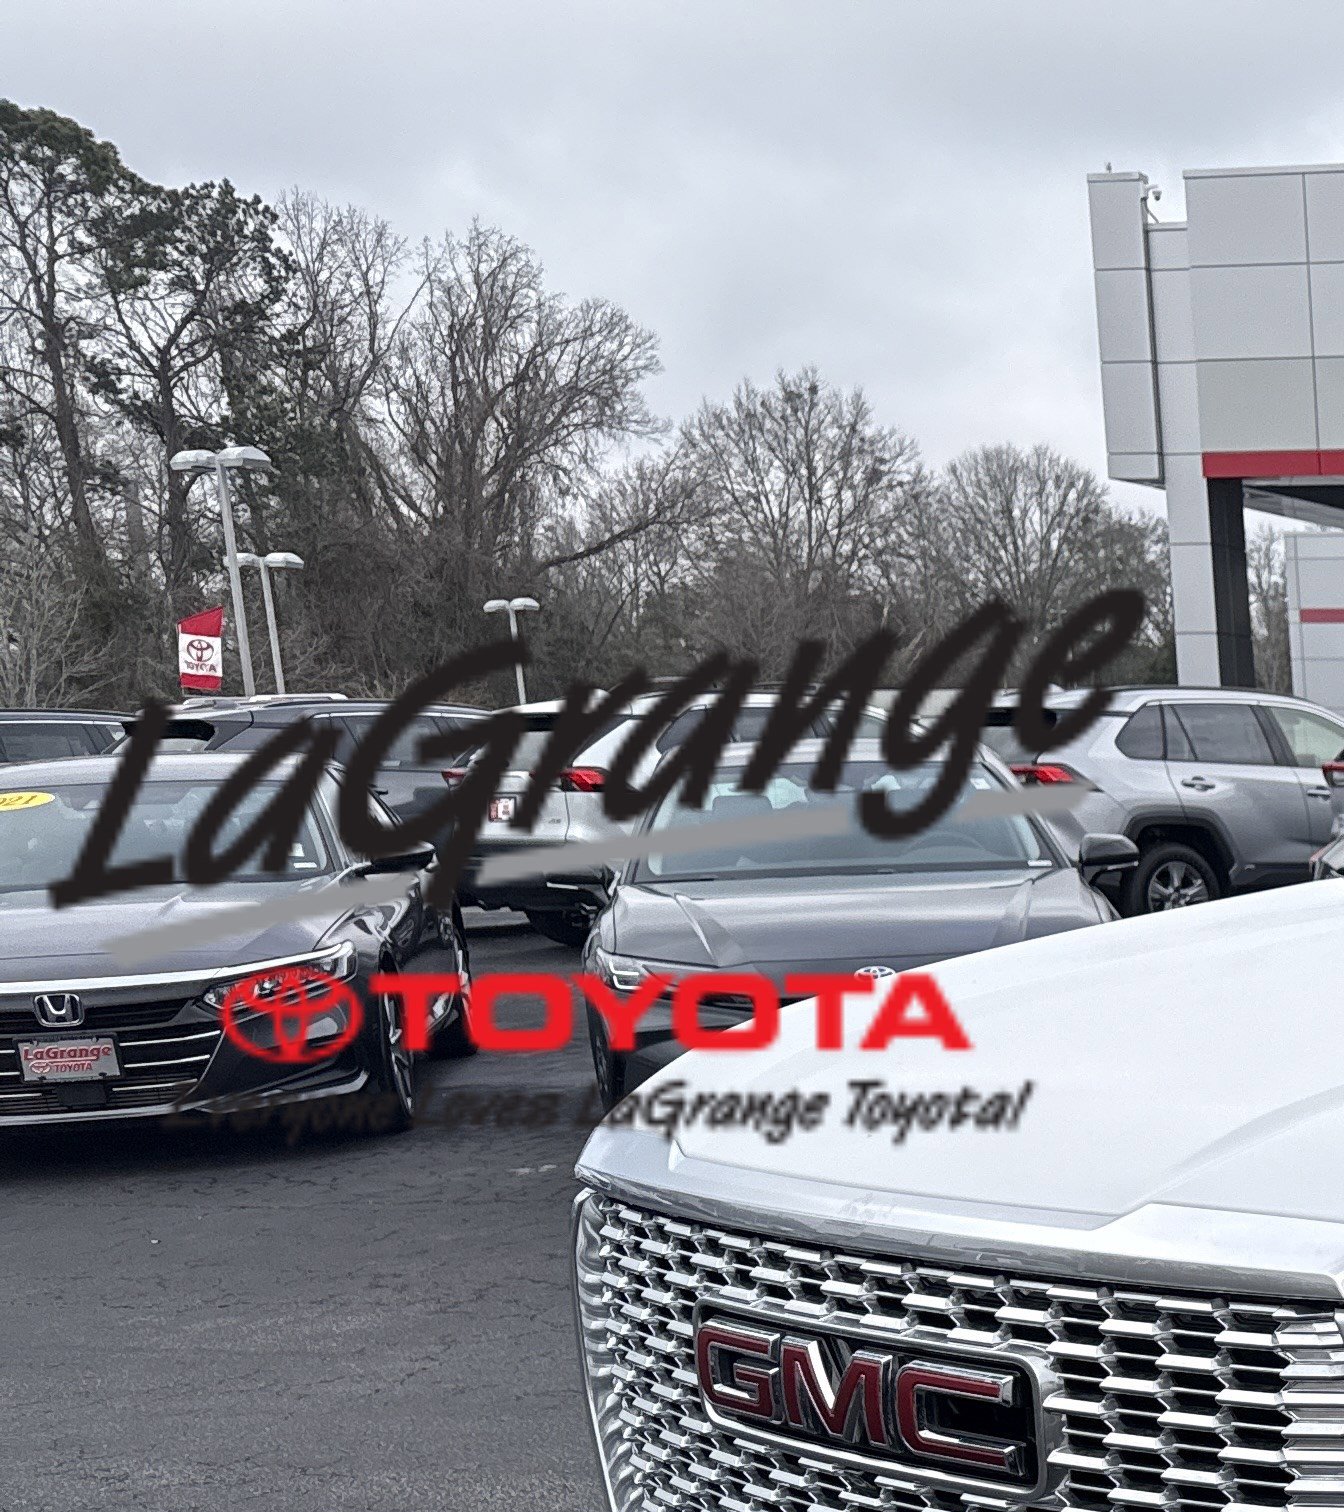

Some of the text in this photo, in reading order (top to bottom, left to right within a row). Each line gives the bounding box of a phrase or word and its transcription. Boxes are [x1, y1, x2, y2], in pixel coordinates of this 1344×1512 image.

[23, 1045, 113, 1062] LaGrange
[54, 1062, 93, 1073] TOYOTA
[700, 1317, 1026, 1476] GMC
